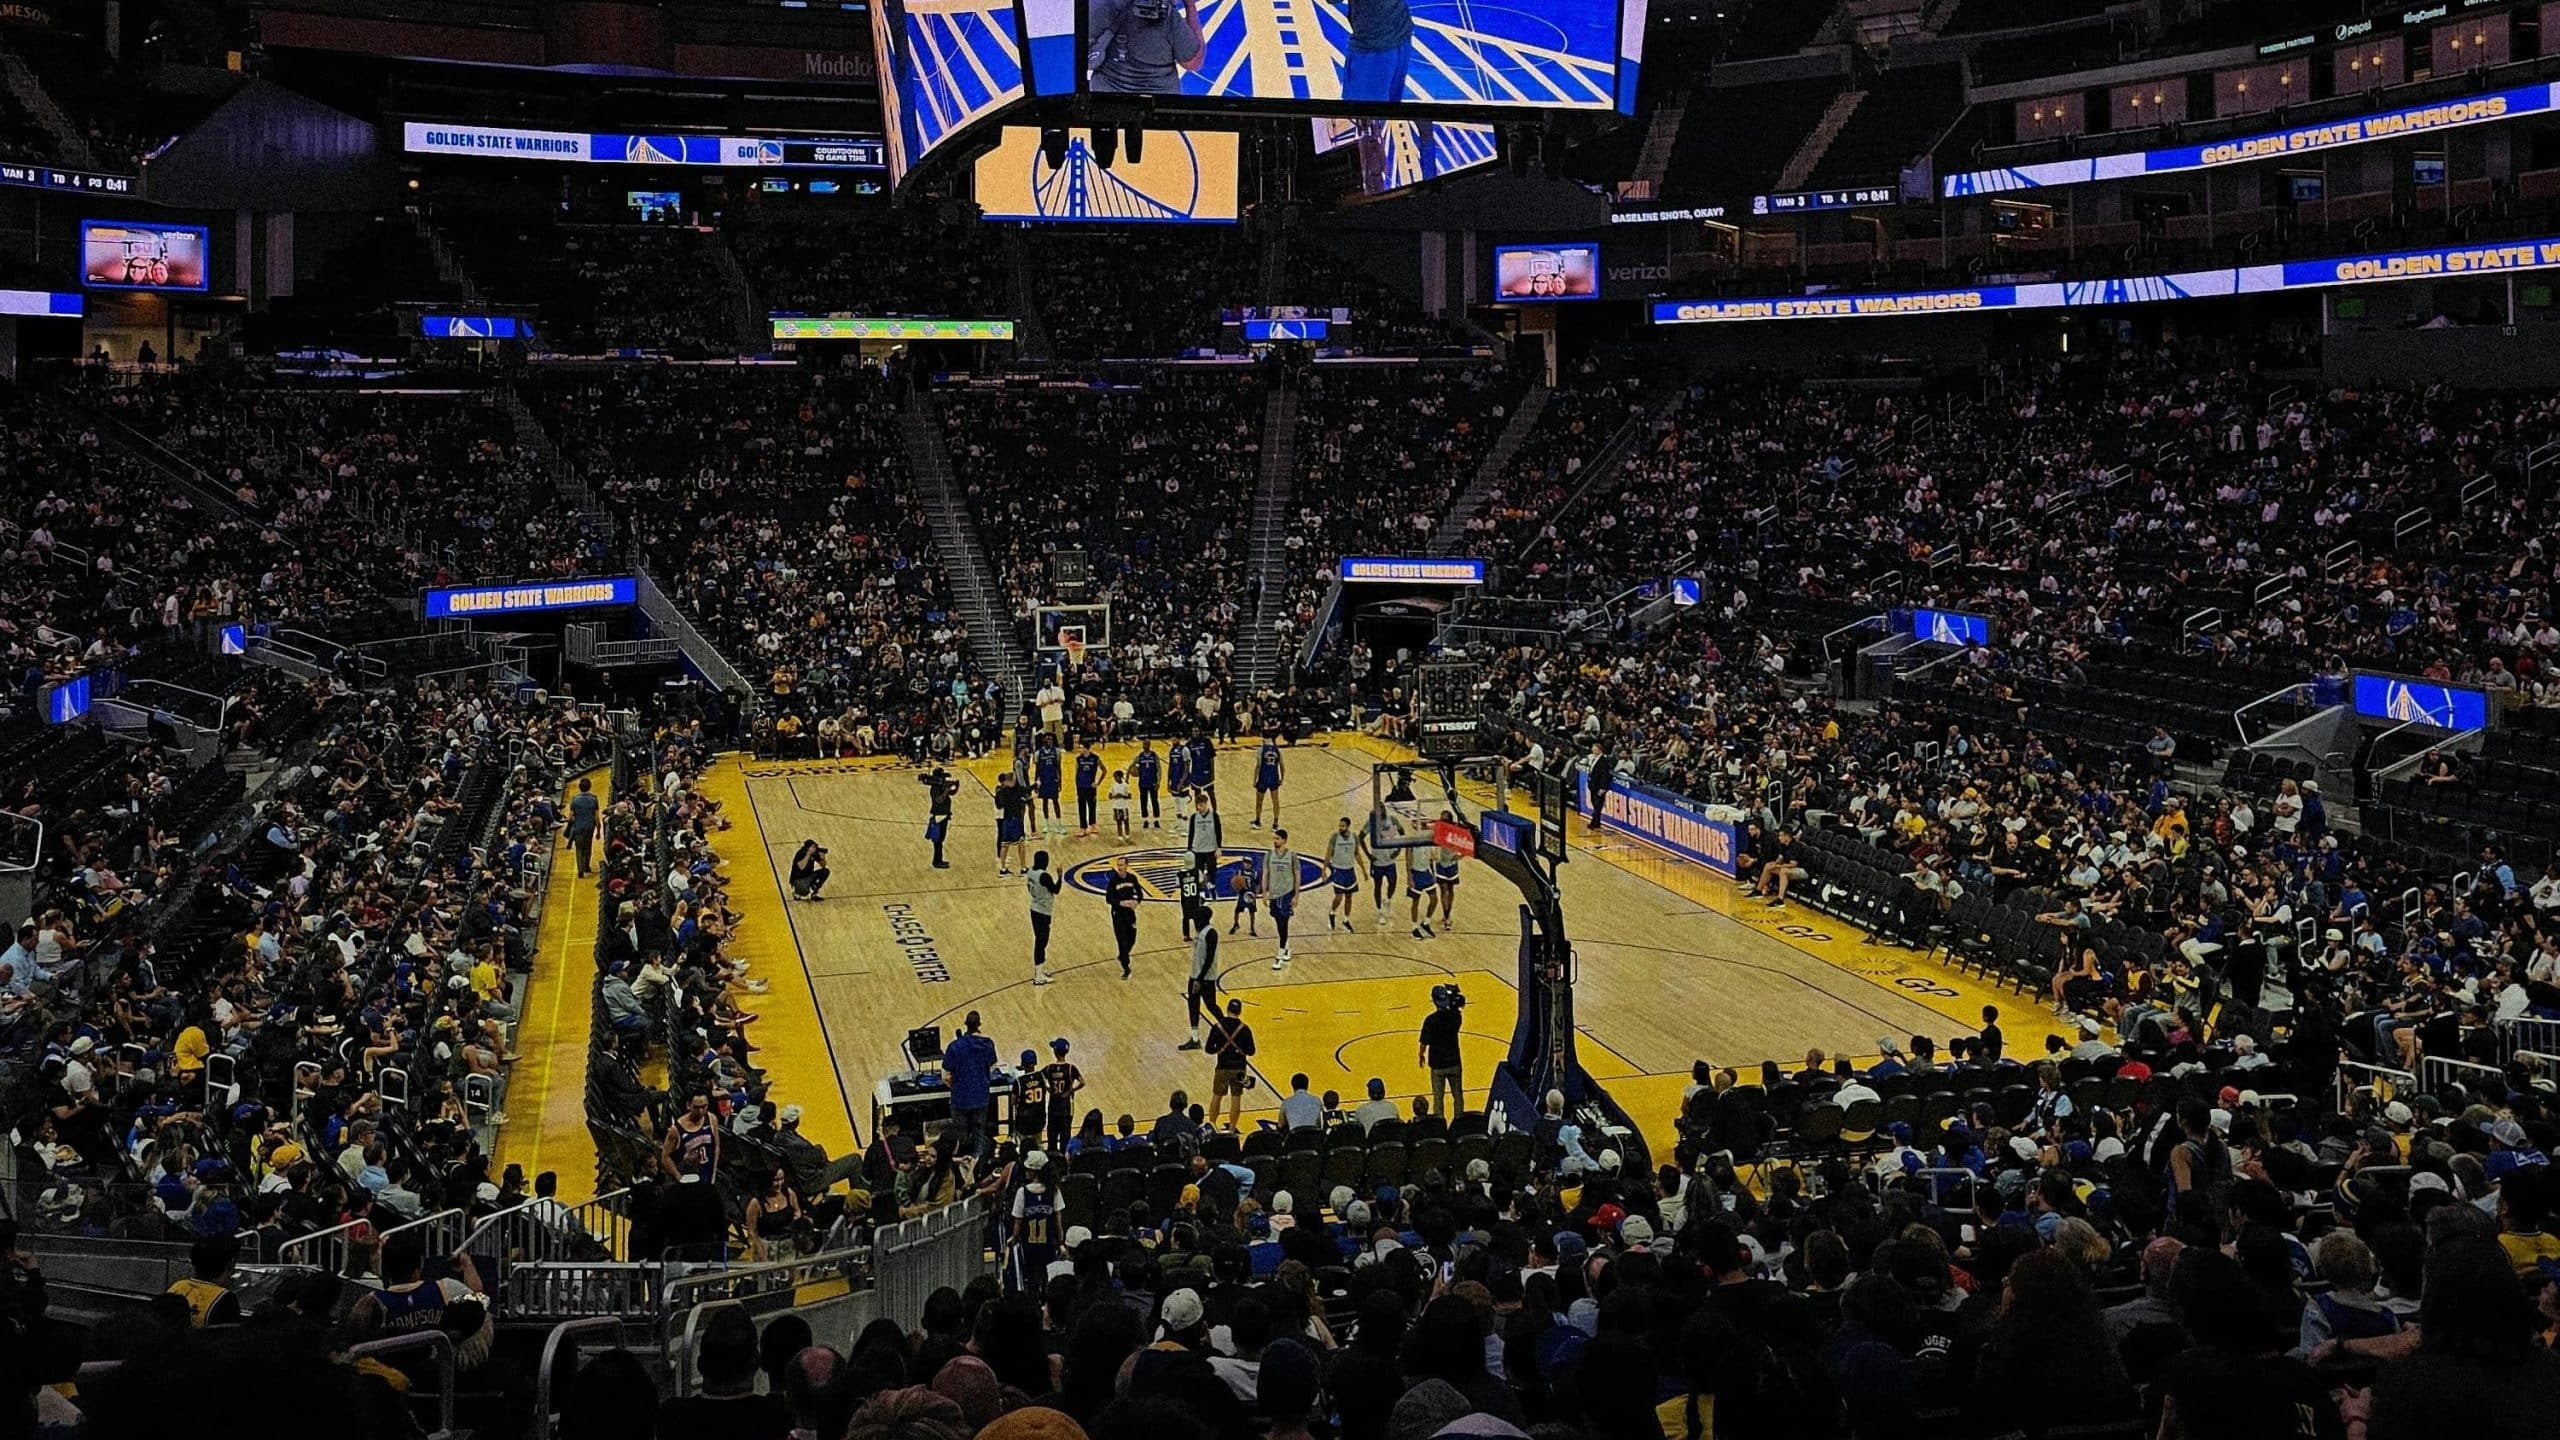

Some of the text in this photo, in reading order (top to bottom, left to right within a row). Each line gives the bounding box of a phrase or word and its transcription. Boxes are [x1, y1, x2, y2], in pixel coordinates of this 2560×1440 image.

[2403, 4, 2446, 23] RingCentral
[2347, 20, 2372, 36] pepsi
[805, 53, 873, 77] Modelo
[2200, 97, 2507, 165] GOLDEN STATE WARRIORS
[426, 131, 579, 154] GOLDEN STATE WARRIORS
[815, 147, 865, 155] COUNTDOWN
[826, 154, 847, 162] GAME
[848, 155, 867, 163] TIME
[2, 168, 24, 180] VAN
[27, 170, 36, 182] 3
[52, 174, 66, 184] TB
[73, 177, 81, 187] 4
[106, 179, 127, 192] 0:41
[1775, 198, 1796, 207] VAN
[1798, 196, 1806, 207] 3
[1820, 195, 1834, 204] TB
[1840, 193, 1848, 204] 4
[1870, 190, 1890, 202] 0:41
[1611, 207, 1725, 224] BASELINE SHOTS, OKAY?
[161, 230, 197, 241] verizon
[2336, 254, 2442, 280] GOLDEN
[2446, 246, 2536, 272] STATE
[1677, 292, 1982, 320] GOLDEN STATE WARRIORS
[2502, 326, 2518, 336] 103
[1351, 563, 1475, 578] GOLDEN STATE WARRIORS
[450, 583, 614, 612] GOLDEN STATE WARRIORS
[1438, 721, 1478, 732] TISSOT
[1629, 797, 1662, 838] STATE
[1662, 810, 1730, 865] WARRIORS
[1776, 925, 1833, 942] GP
[883, 903, 952, 985] CHASE CENTER
[1895, 977, 1960, 998] GP
[470, 1089, 481, 1097] 14
[1025, 1087, 1042, 1104] 30
[1028, 1217, 1048, 1244] 11
